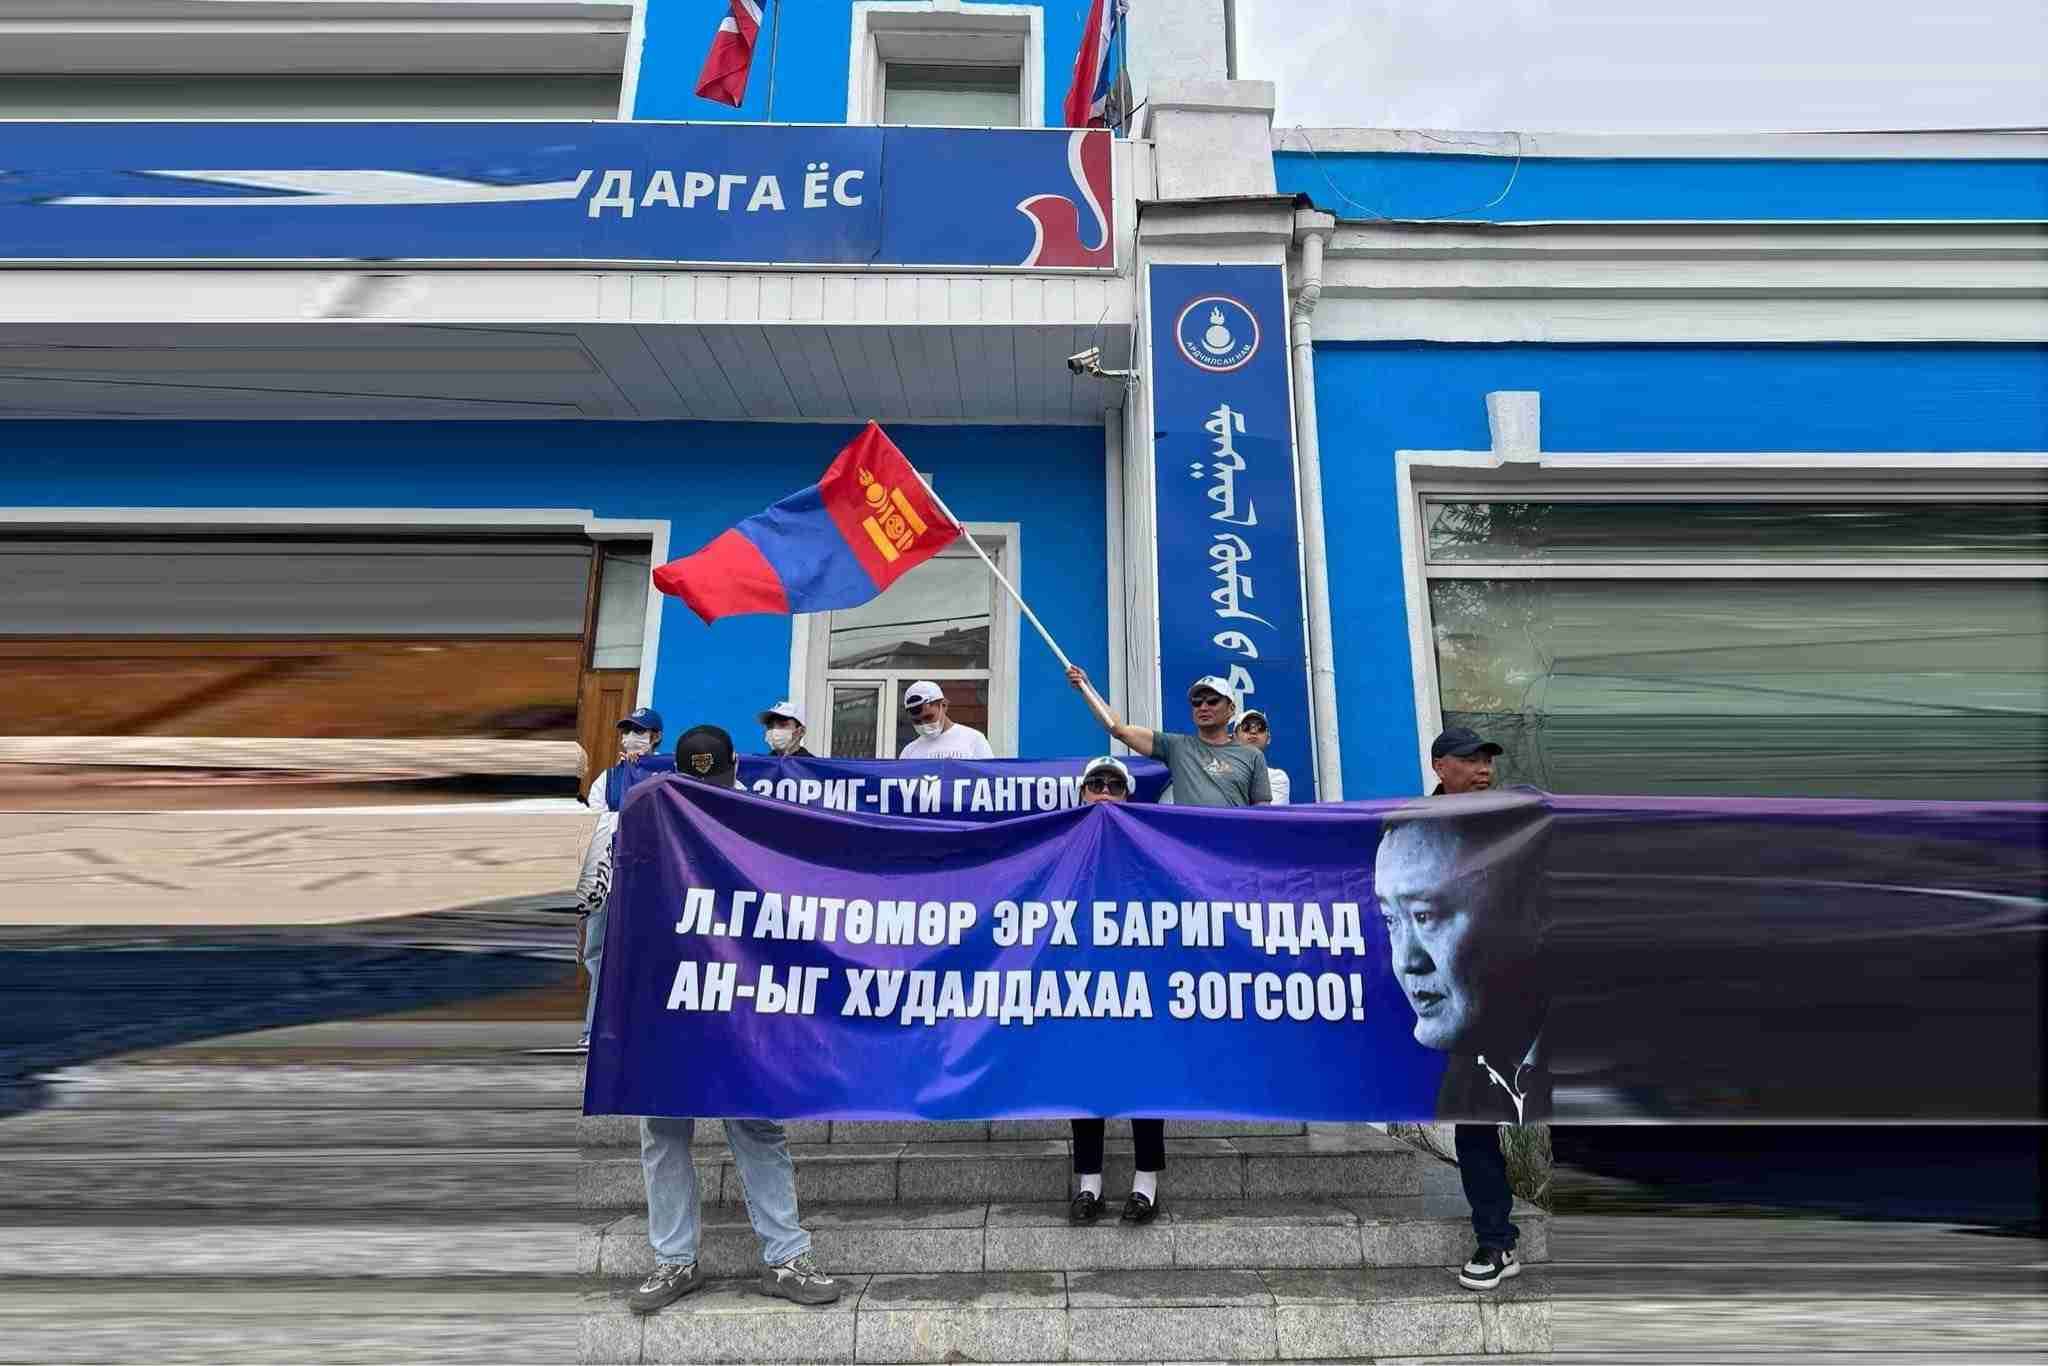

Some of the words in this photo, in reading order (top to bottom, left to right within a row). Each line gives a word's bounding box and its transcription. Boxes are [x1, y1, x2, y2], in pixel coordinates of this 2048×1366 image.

[803, 162, 865, 209] ЁС
[953, 775, 1137, 813] ГАНТӨМ
[675, 888, 977, 946] Л.ГАНТӨМӨР
[992, 900, 1078, 947] ЭРХ
[1092, 901, 1366, 956] БАРИГЧДАД
[666, 961, 829, 1015] АН-ЫГ
[841, 969, 1153, 1026] ХУДАЛДАХАА
[1167, 971, 1365, 1022] ЗОГСОО!
